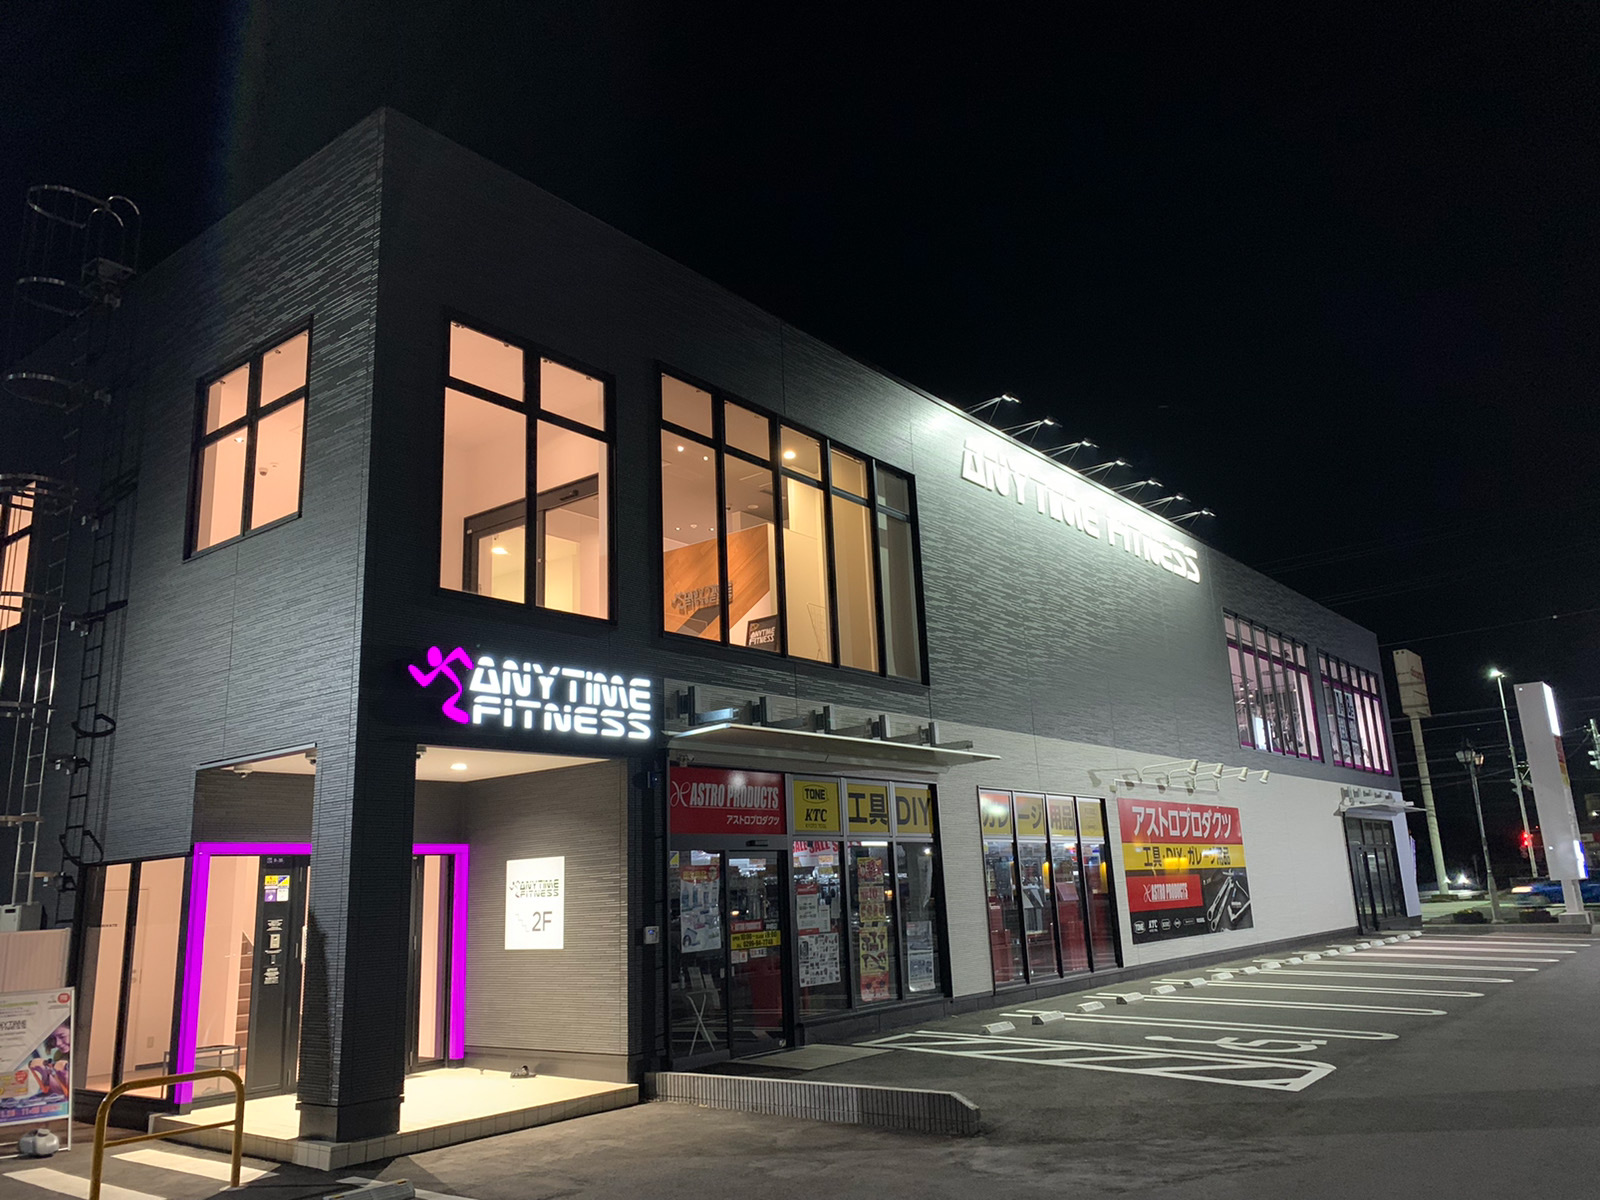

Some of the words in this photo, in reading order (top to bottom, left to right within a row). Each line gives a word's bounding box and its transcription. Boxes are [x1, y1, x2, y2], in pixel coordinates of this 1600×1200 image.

[961, 439, 1101, 540] ANYTIME
[1104, 511, 1201, 584] FITNESS
[749, 634, 775, 646] FITNESS
[750, 626, 776, 639] ANYTIME
[469, 656, 652, 711] ANYTIME
[472, 695, 652, 740] FITNESS
[690, 782, 725, 807] ASTRO
[727, 784, 779, 809] PRODUCTS
[804, 788, 826, 800] TONE
[805, 808, 828, 823] KTC
[848, 792, 888, 825] 工具
[896, 795, 931, 826] DIY
[726, 814, 780, 825] アストロプロダクツ
[1131, 806, 1232, 838] アストロプロダクツ
[520, 878, 560, 890] ANYTIME
[520, 889, 560, 898] FITNESS
[1151, 883, 1165, 902] ASTRO
[1166, 882, 1189, 901] PRODUCTS
[532, 911, 553, 931] 2F
